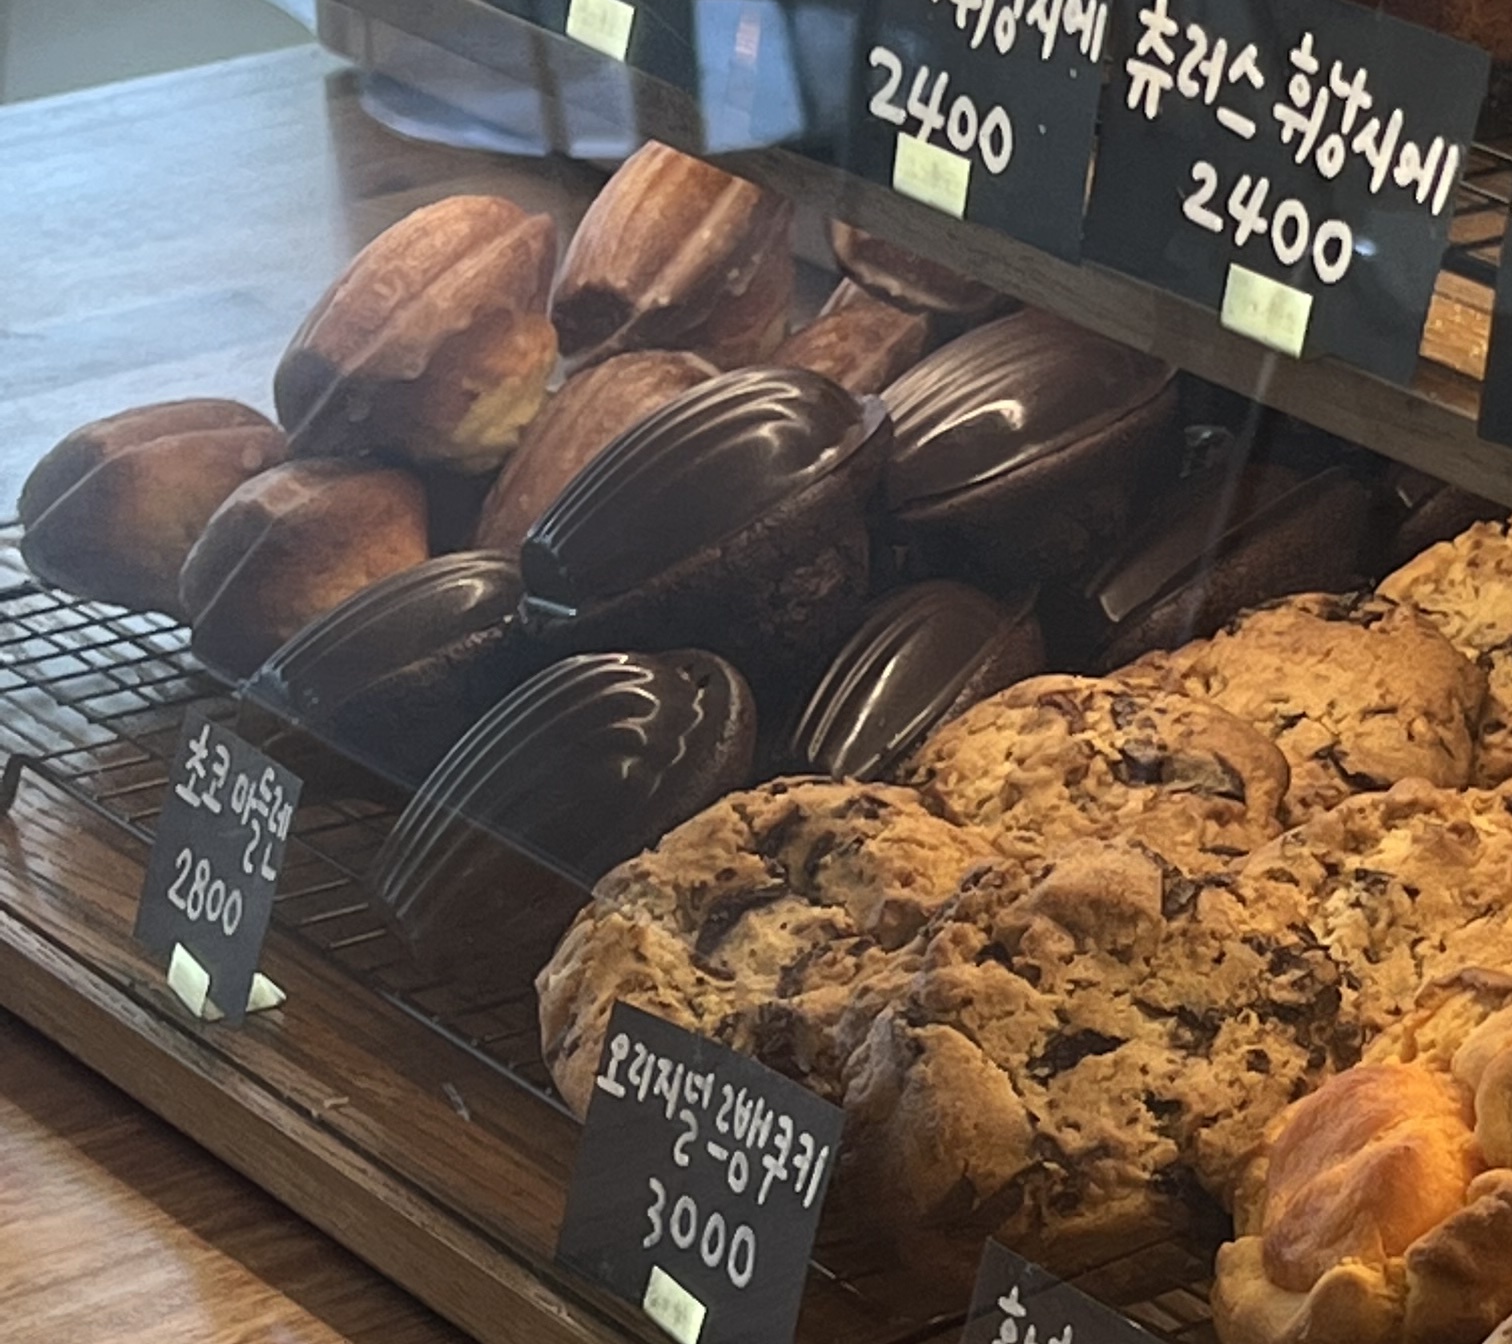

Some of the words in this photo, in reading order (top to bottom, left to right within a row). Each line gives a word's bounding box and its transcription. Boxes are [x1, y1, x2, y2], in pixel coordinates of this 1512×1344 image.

[868, 45, 1013, 174] 2400
[1273, 33, 1460, 216] 휘낭시에
[1182, 160, 1354, 285] 2400
[175, 724, 230, 814] 초코
[167, 848, 243, 936] 2800
[642, 1176, 756, 1289] 3000
